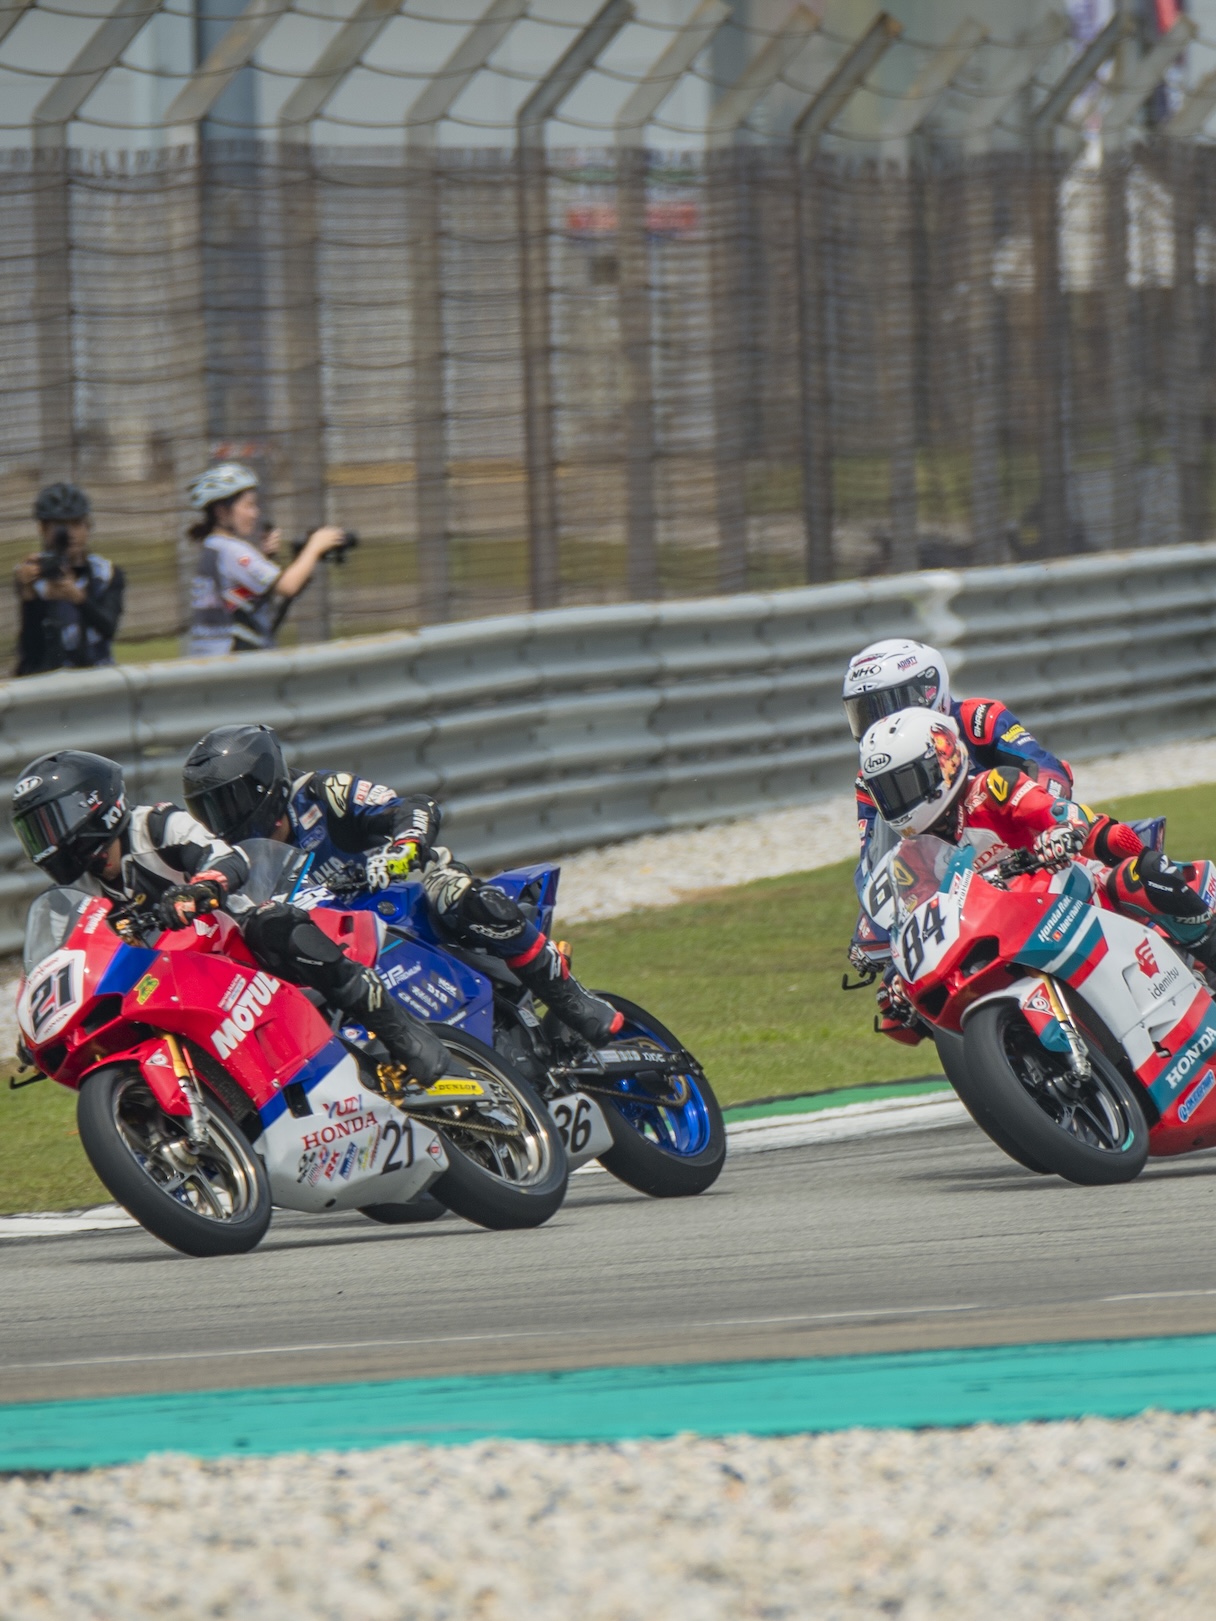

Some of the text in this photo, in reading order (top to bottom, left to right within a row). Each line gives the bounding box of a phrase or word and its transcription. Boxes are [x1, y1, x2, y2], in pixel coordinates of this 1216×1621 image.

[974, 703, 987, 738] SHARK
[866, 753, 887, 769] Arai
[902, 897, 947, 982] 84
[1038, 909, 1061, 943] Honda
[30, 961, 76, 1036] 21
[1147, 966, 1180, 999] idemitsu
[210, 971, 281, 1060] MOTUL
[438, 1083, 477, 1091] DUNLOP
[302, 1111, 378, 1151] HONDA
[380, 1115, 414, 1176] 21
[554, 1098, 592, 1154] 36
